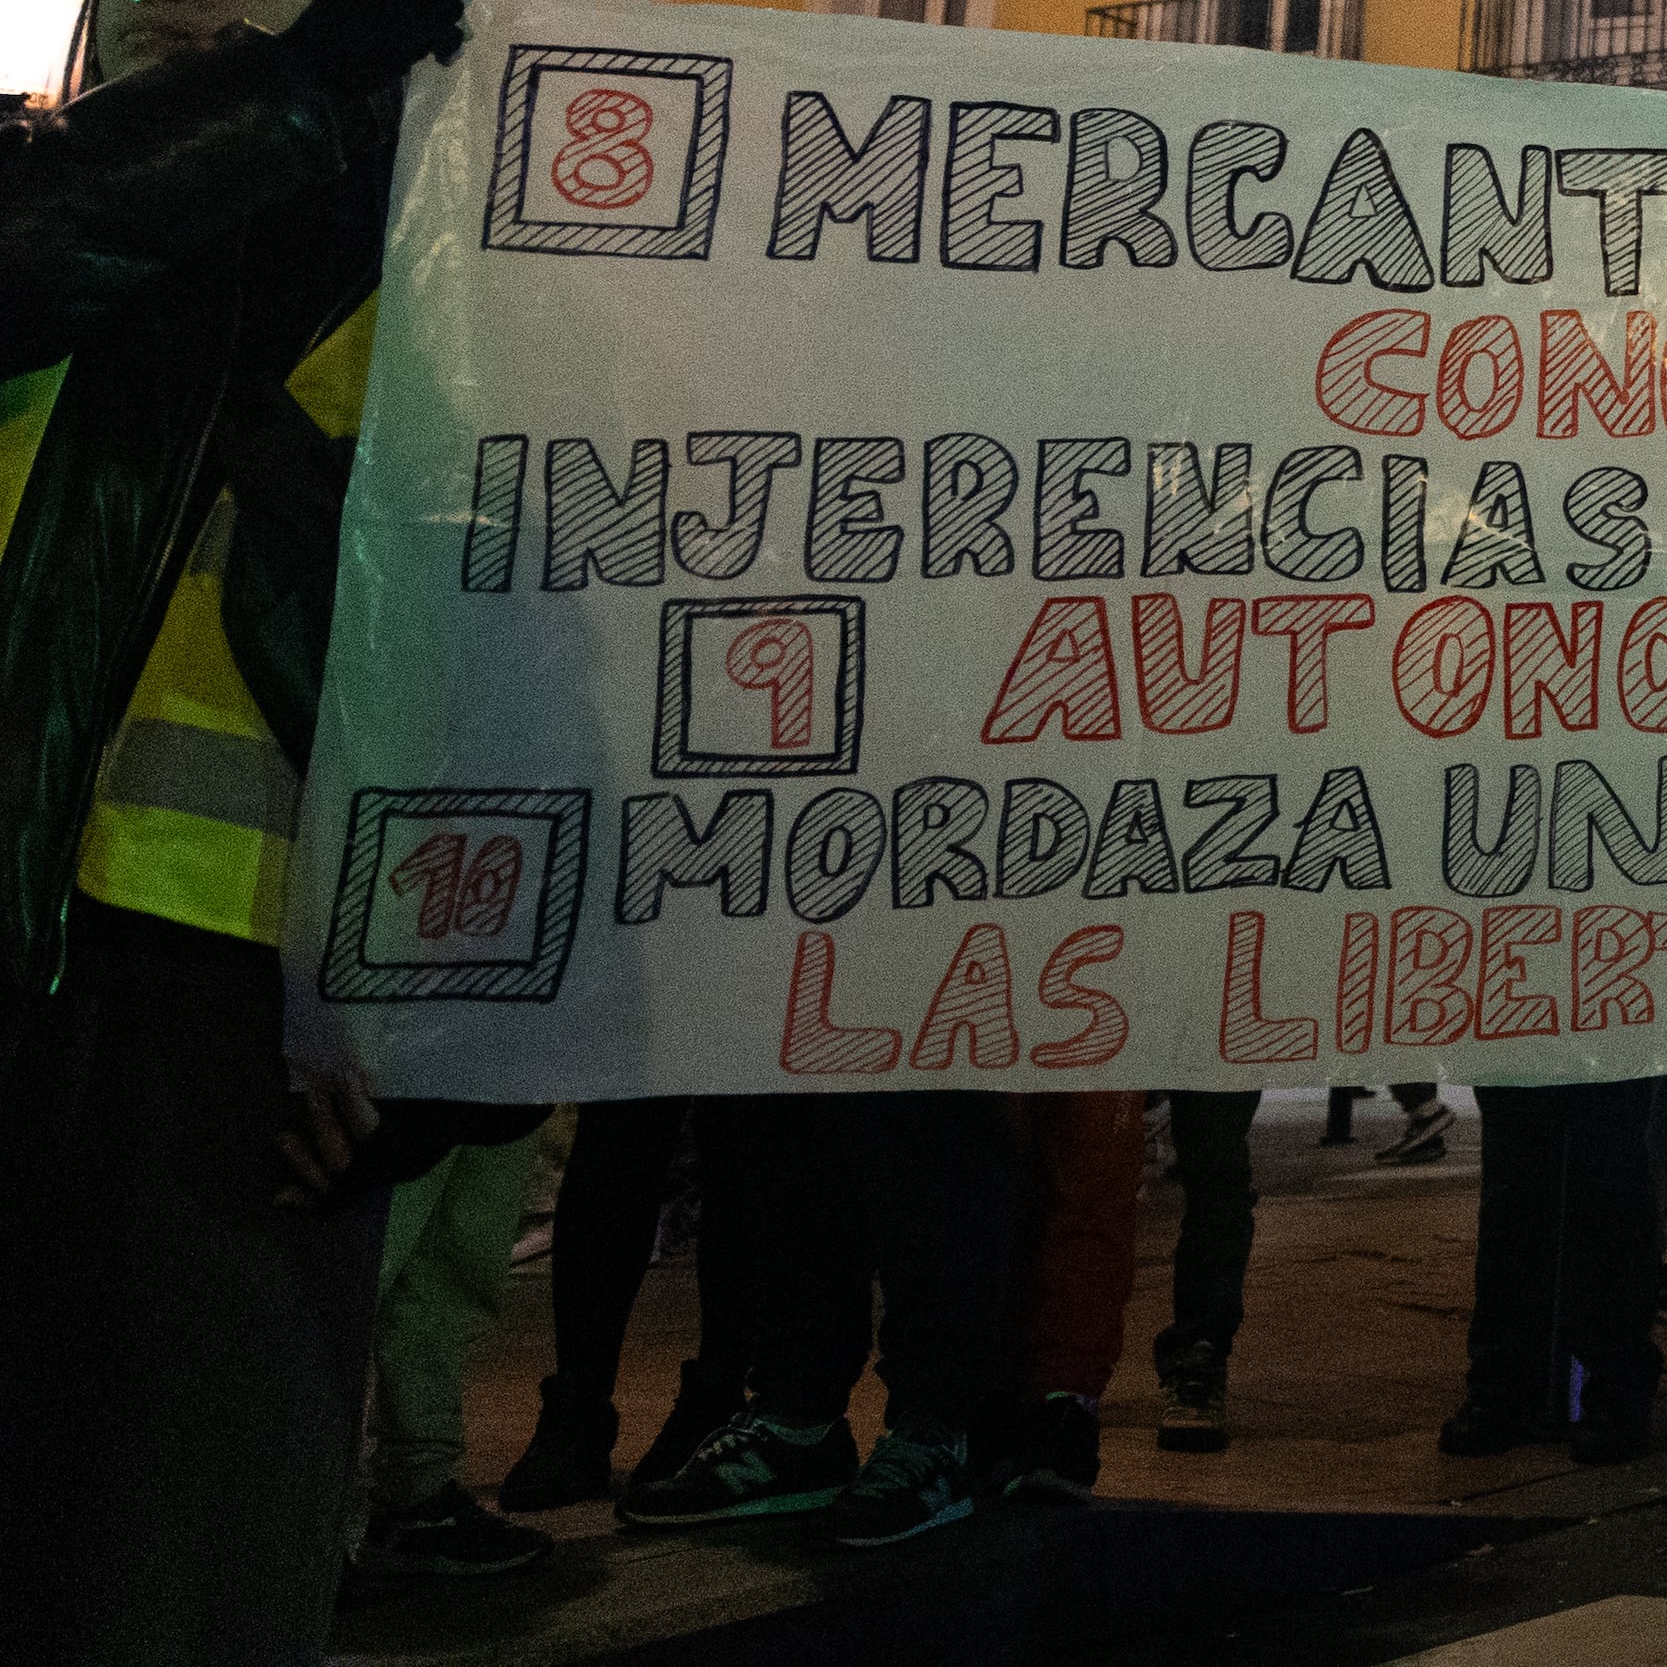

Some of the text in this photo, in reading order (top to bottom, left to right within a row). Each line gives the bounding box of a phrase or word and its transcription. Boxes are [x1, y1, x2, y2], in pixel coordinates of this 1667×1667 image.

[550, 88, 653, 209] 8
[462, 430, 1652, 593] INJERENCIAS
[726, 618, 814, 749] 9
[388, 832, 524, 939] 10
[613, 765, 1392, 925] MORDAZA
[779, 922, 1130, 1075] LAS
